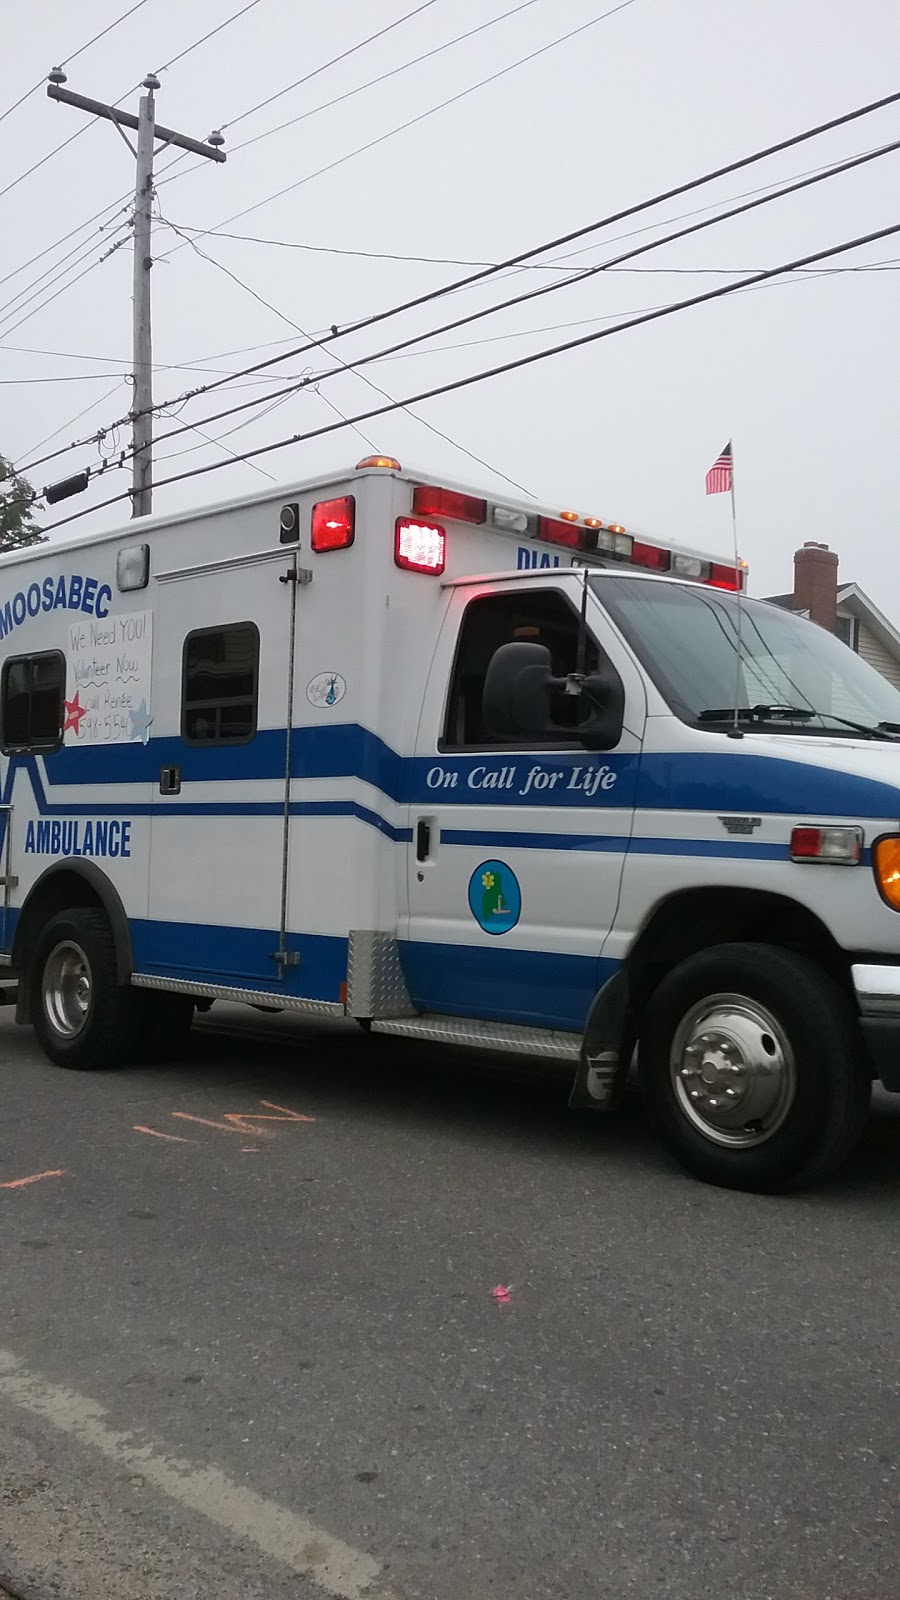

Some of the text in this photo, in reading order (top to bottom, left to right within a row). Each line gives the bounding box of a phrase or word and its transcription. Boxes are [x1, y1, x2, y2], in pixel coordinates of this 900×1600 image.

[0, 575, 112, 640] MOOSABEC
[70, 614, 146, 651] We Need YOU!
[73, 652, 139, 682] Volunteer Now
[426, 766, 617, 796] On Call for Life
[24, 820, 131, 857] AMBULANCE
